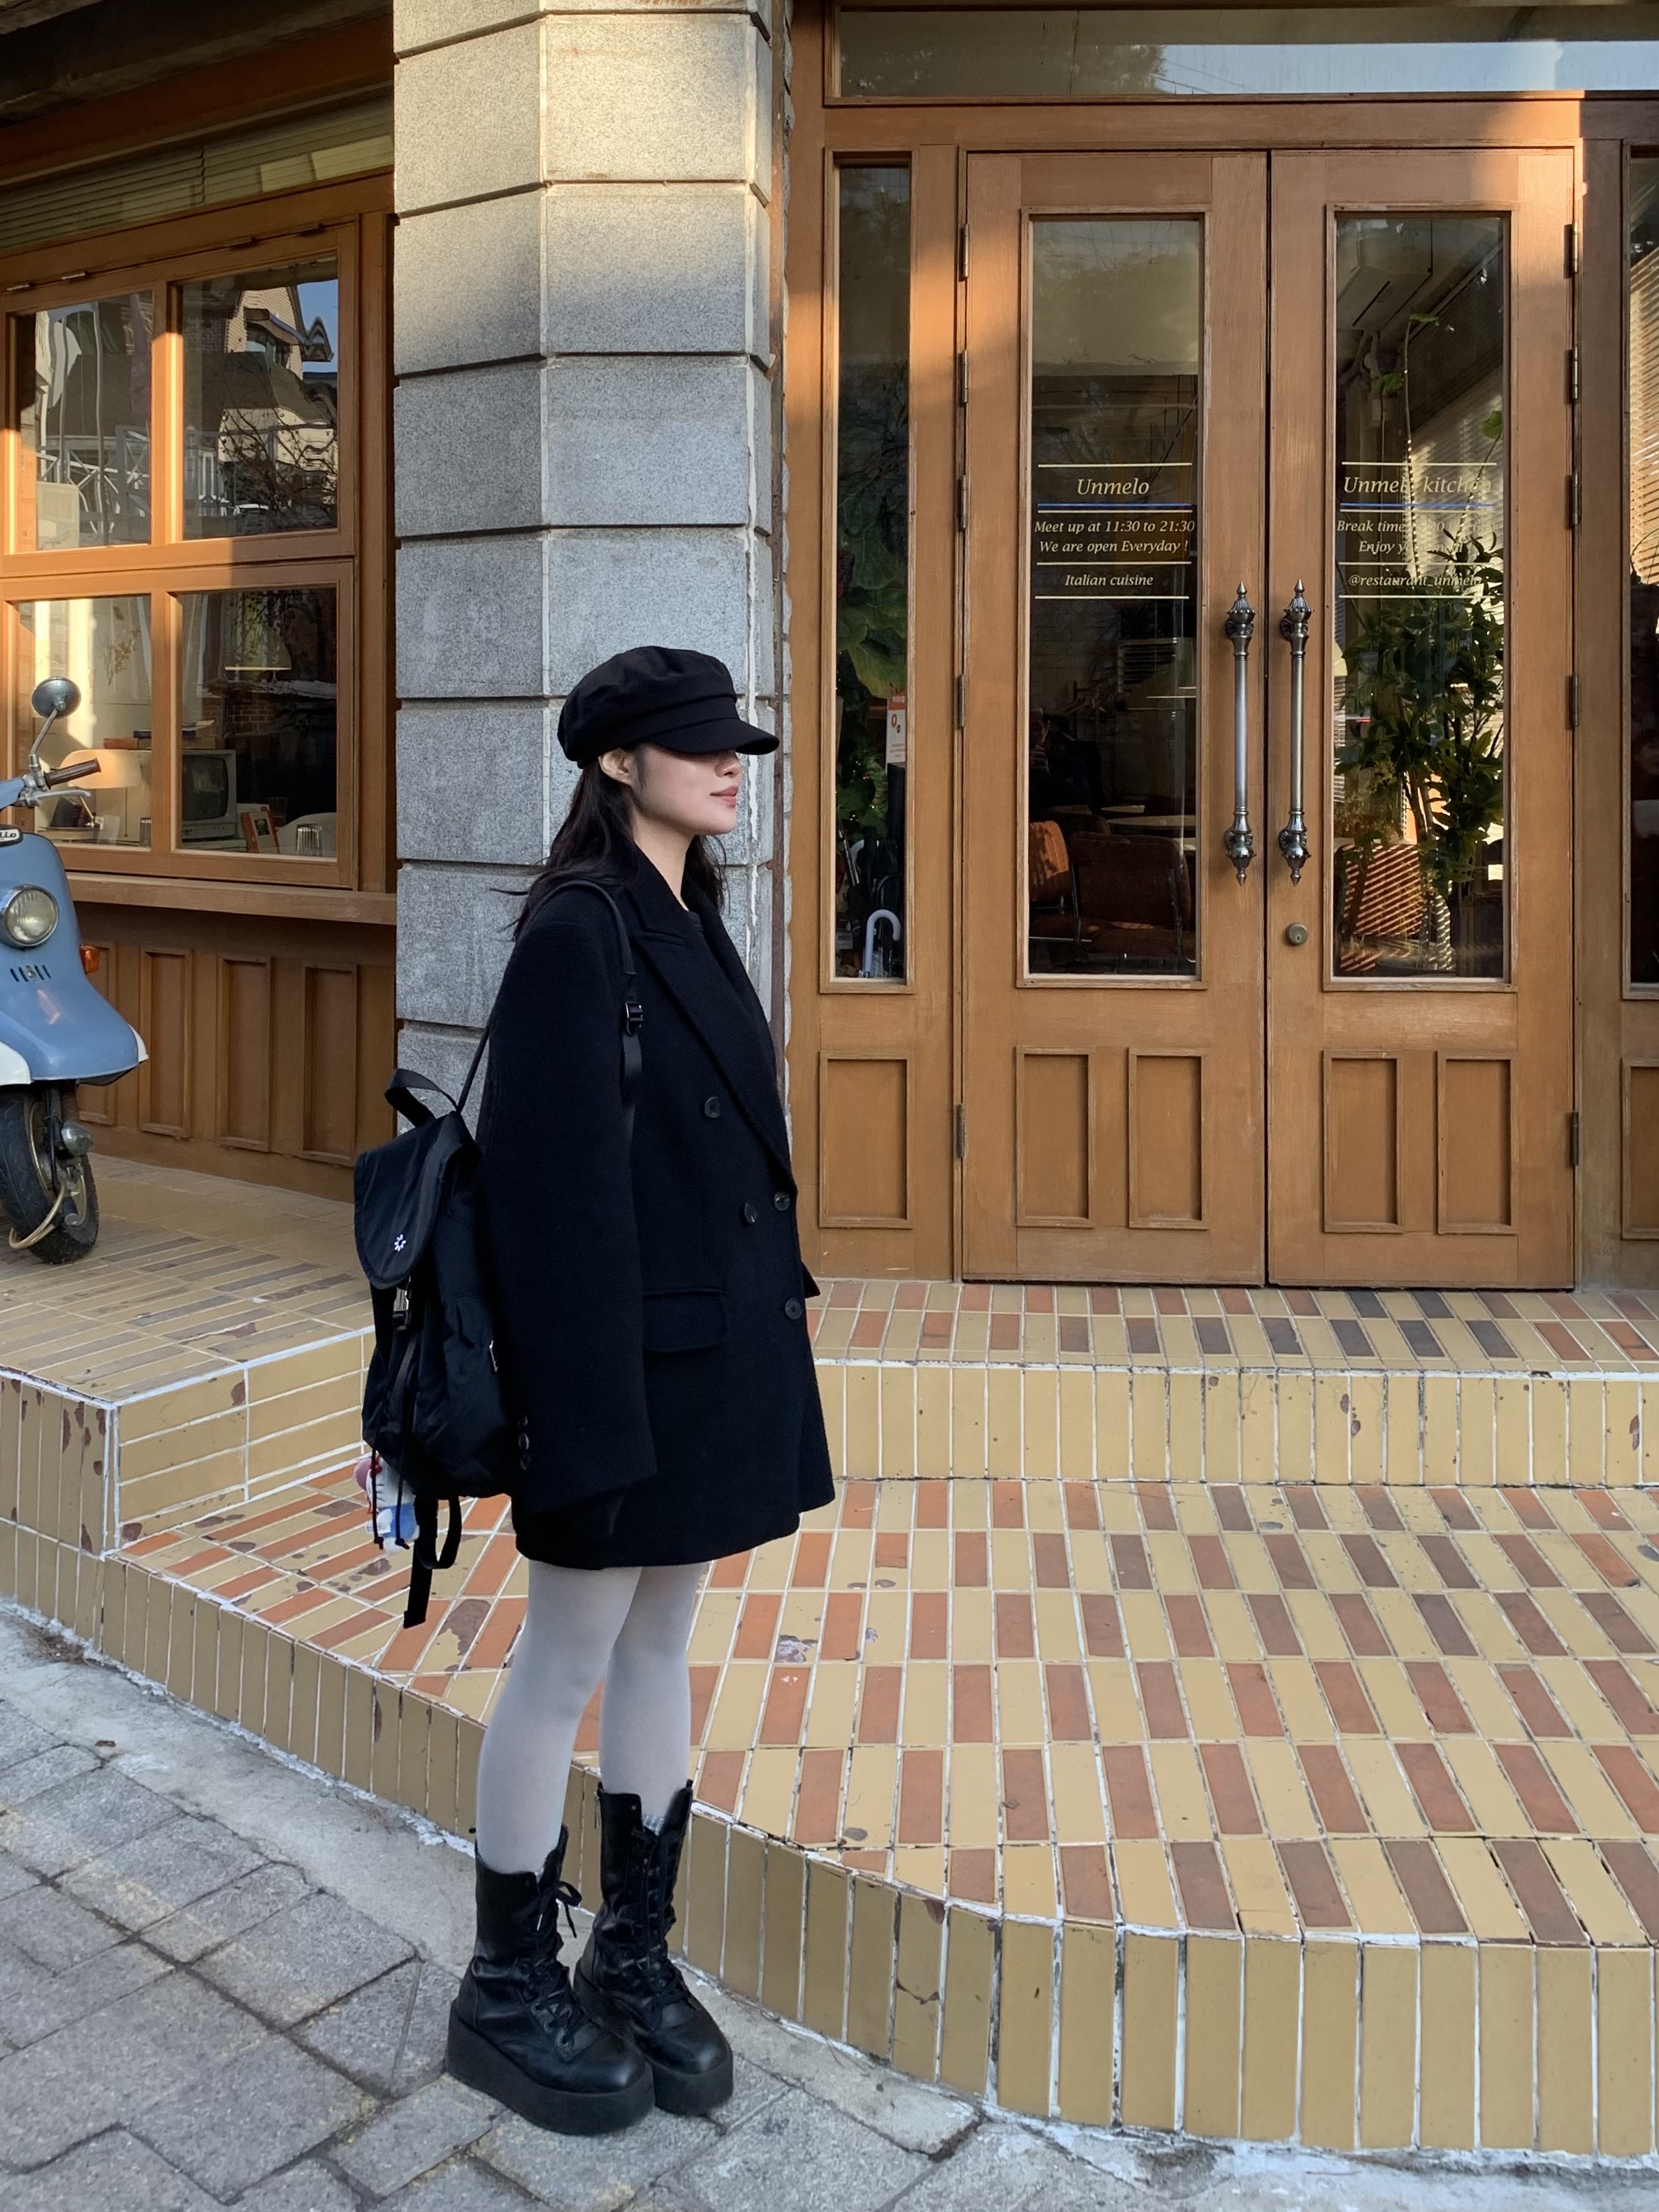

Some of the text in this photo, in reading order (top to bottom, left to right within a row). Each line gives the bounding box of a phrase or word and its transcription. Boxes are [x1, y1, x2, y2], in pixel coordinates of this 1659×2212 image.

[1077, 478, 1150, 495] Unmelo
[1034, 521, 1195, 534] Meet up at 11:30 to 21:30
[1337, 521, 1374, 532] Break
[1377, 521, 1405, 532] time
[1040, 541, 1059, 552] We
[1062, 544, 1083, 552] are
[1087, 543, 1117, 554] open
[1121, 540, 1180, 554] Everyday
[1359, 540, 1396, 554] Enjoy
[1065, 574, 1153, 585] Italian cuisine
